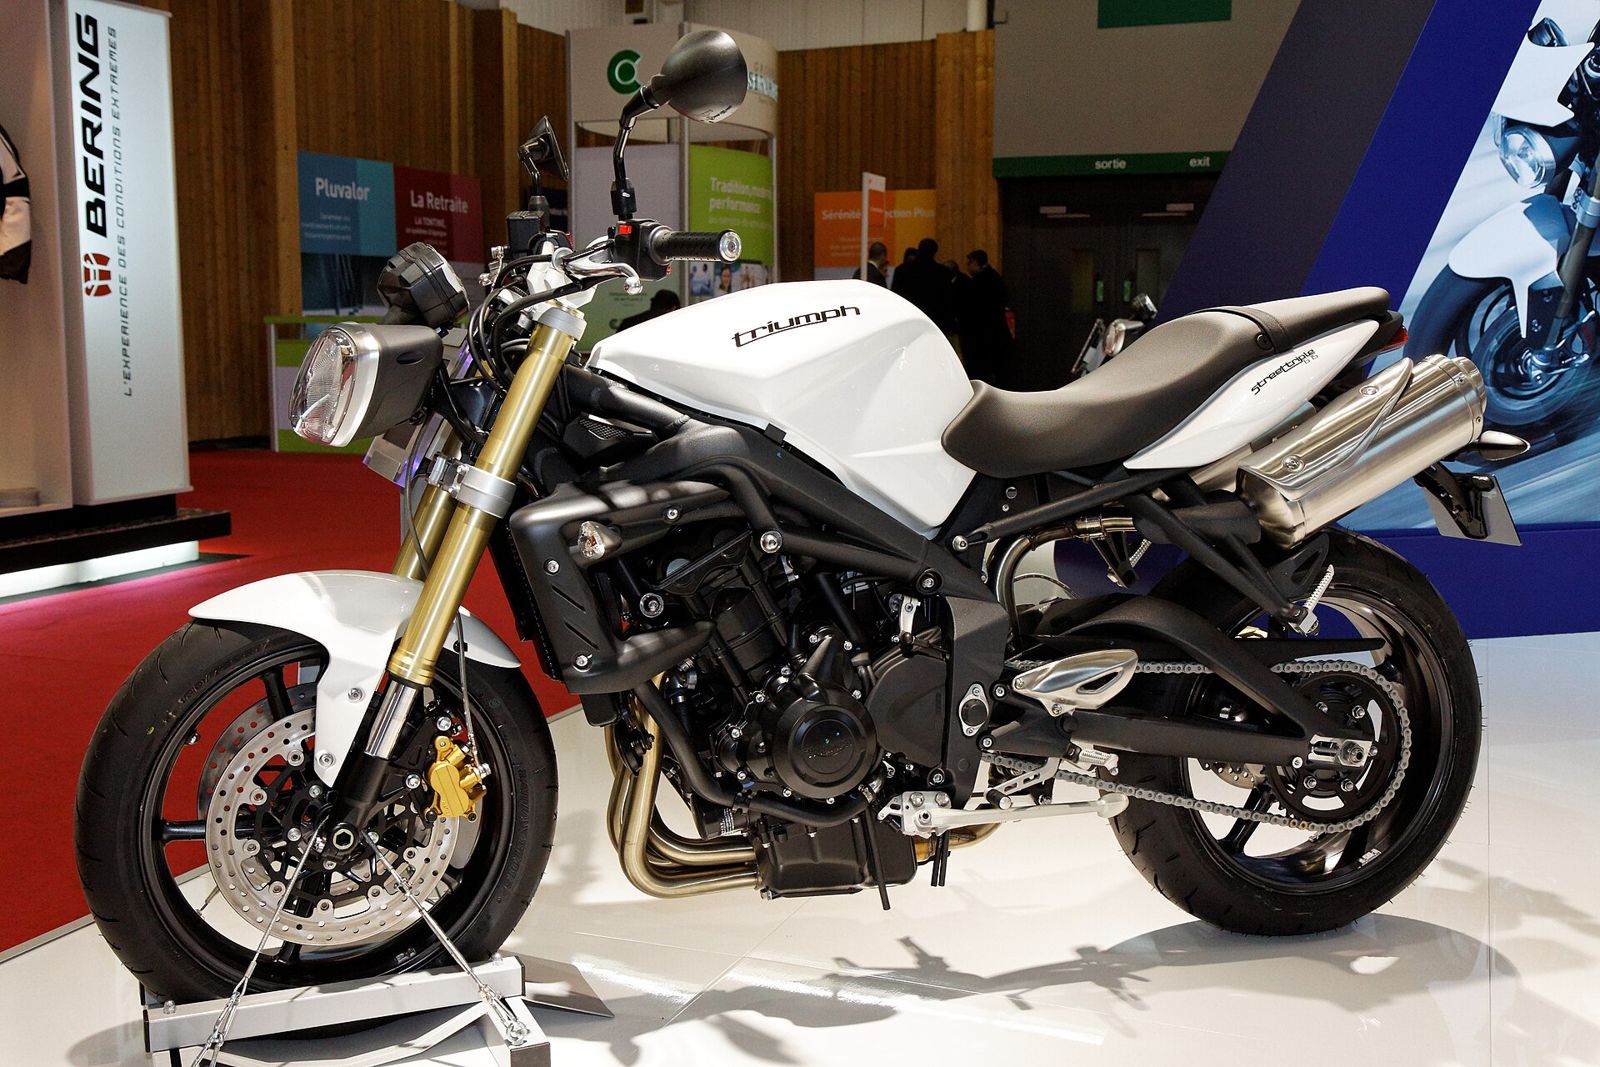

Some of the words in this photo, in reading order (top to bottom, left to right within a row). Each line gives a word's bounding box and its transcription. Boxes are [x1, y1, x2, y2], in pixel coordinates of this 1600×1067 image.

[75, 12, 108, 238] BERING
[112, 125, 125, 229] CONDITIONS
[1094, 157, 1127, 170] sortie
[1189, 156, 1211, 168] exit
[314, 176, 371, 202] Pluvalor
[410, 189, 425, 208] La
[426, 191, 469, 214] Retraite
[117, 234, 127, 268] DES
[731, 305, 861, 348] triumph
